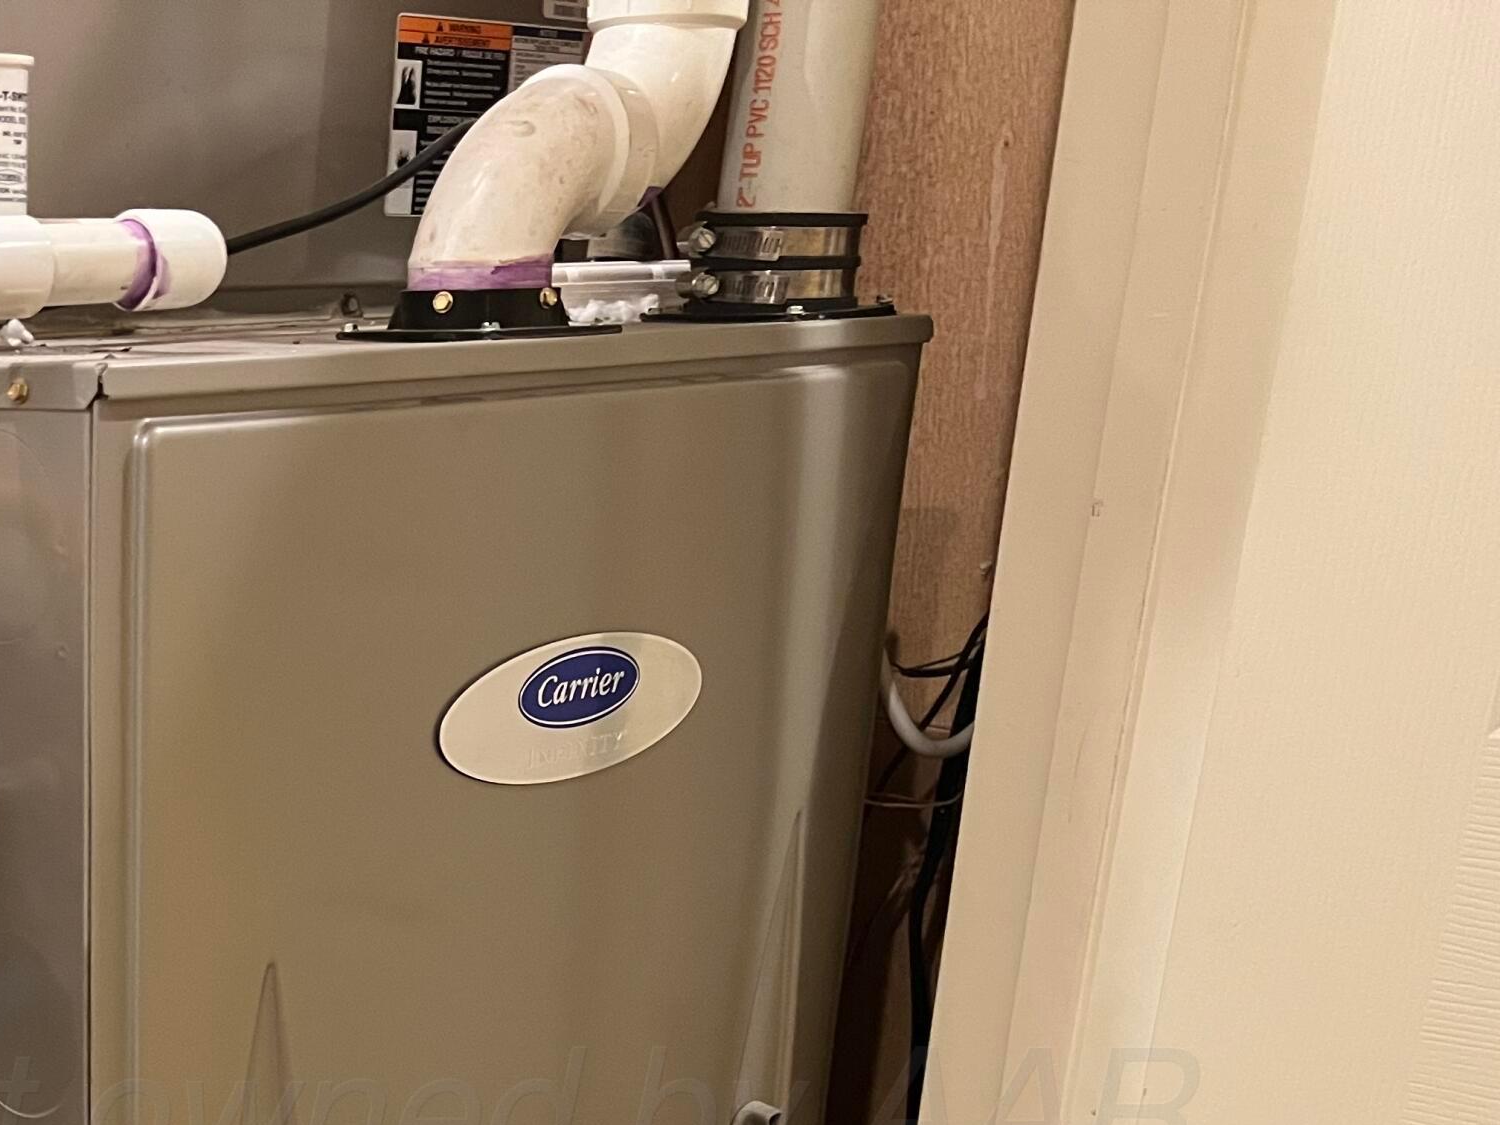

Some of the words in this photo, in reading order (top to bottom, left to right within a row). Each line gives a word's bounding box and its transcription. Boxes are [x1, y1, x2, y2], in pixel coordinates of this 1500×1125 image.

[758, 12, 783, 51] SCH
[753, 55, 776, 95] 1120
[746, 99, 770, 138] PVC
[739, 142, 762, 182] TUP
[537, 667, 625, 708] Carrier
